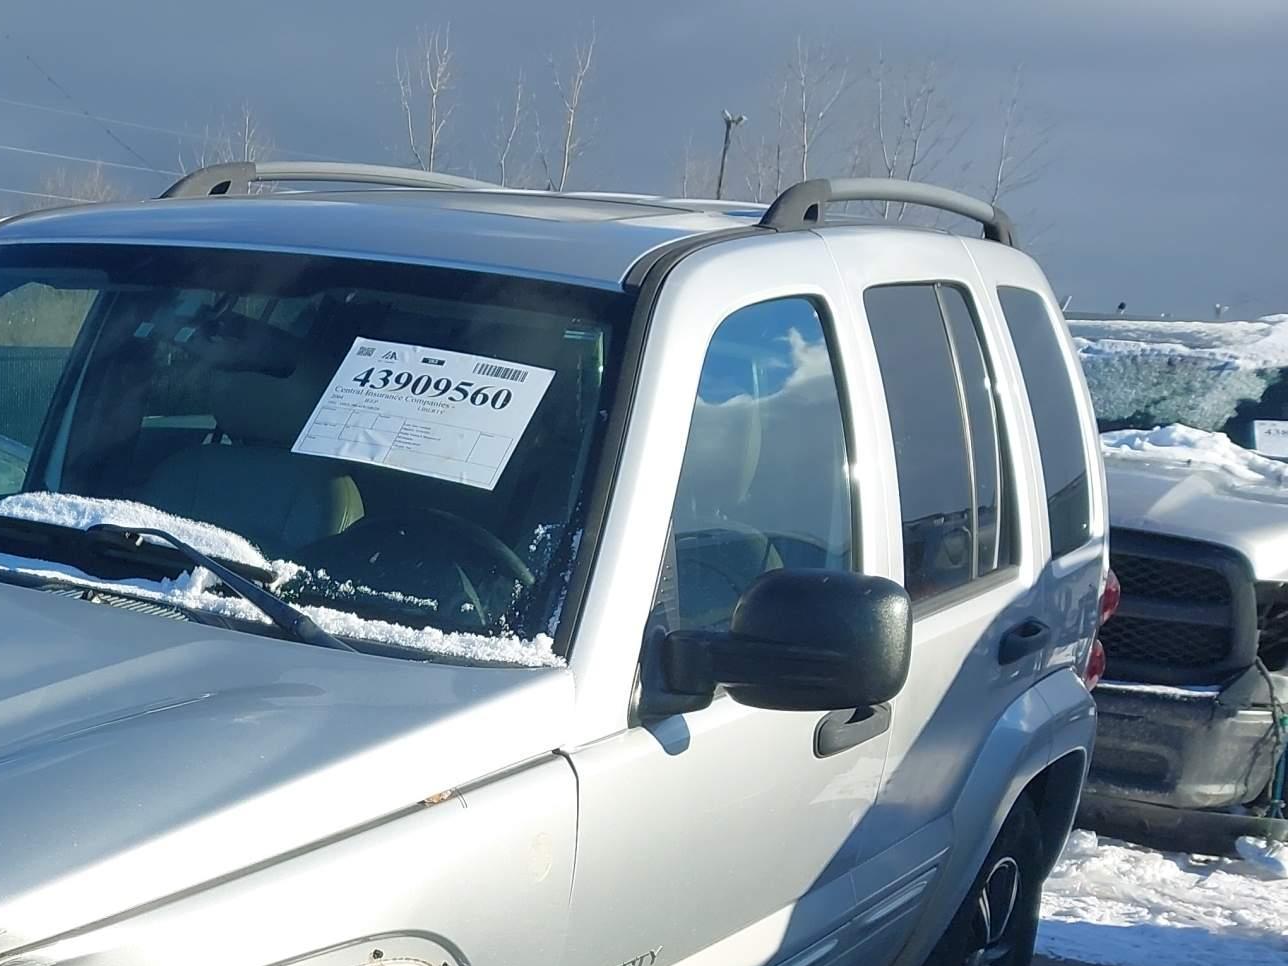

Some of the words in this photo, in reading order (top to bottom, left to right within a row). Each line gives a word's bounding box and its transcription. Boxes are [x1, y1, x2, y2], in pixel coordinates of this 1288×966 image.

[334, 385, 364, 396] Central
[364, 388, 403, 400] Insurance
[405, 395, 449, 408] Companies
[352, 367, 513, 410] 43909560
